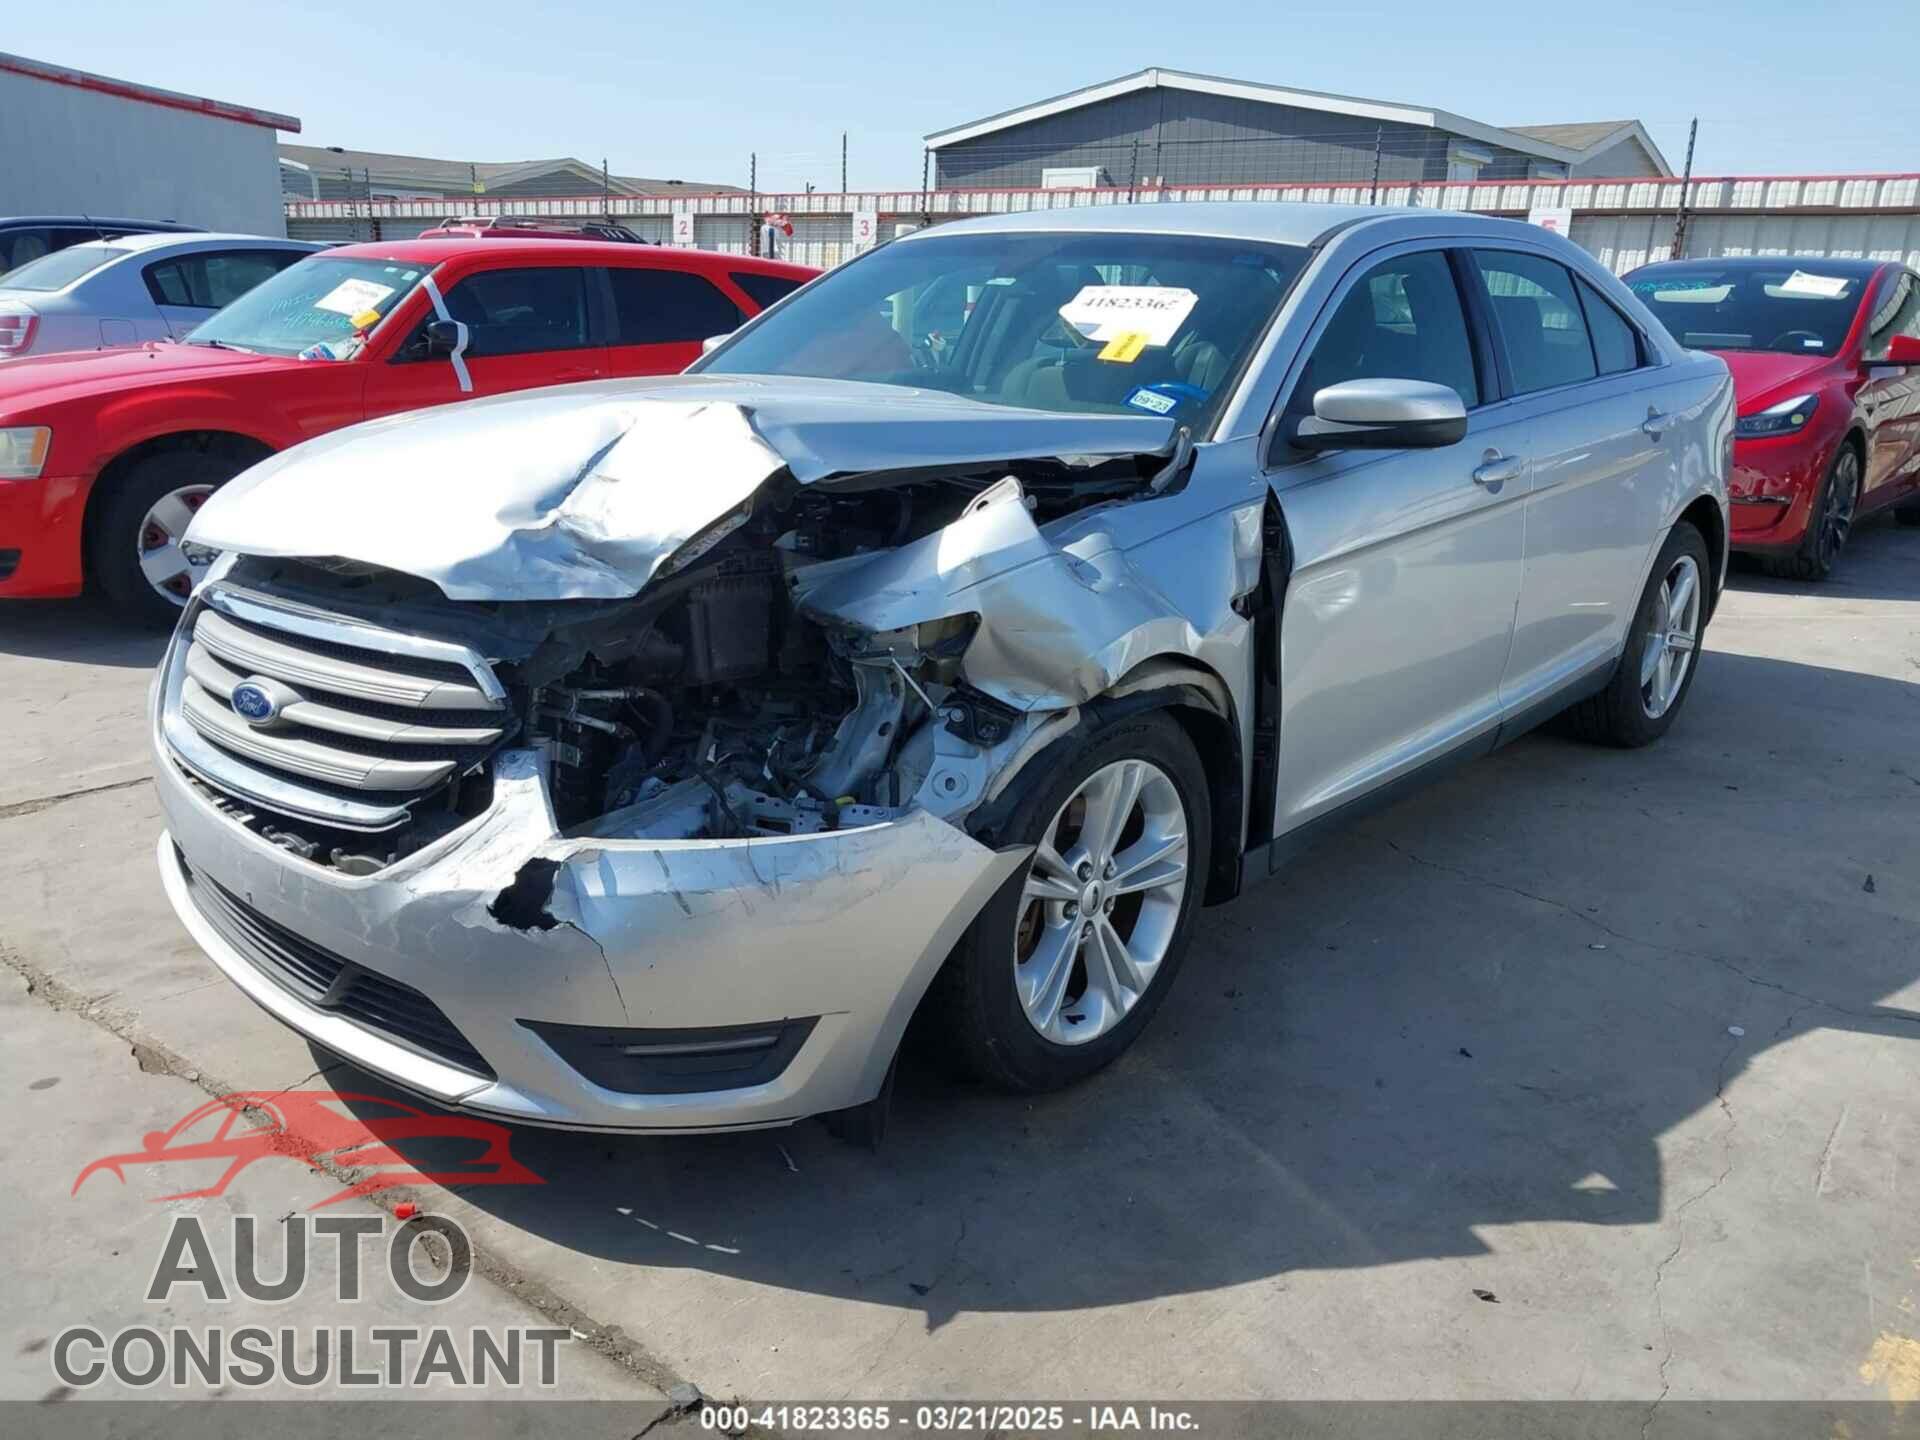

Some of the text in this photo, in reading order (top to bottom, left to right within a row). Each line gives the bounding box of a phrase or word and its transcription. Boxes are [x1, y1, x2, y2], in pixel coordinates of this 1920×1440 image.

[679, 220, 688, 236] 2
[859, 219, 870, 237] 3
[239, 689, 268, 715] Ford
